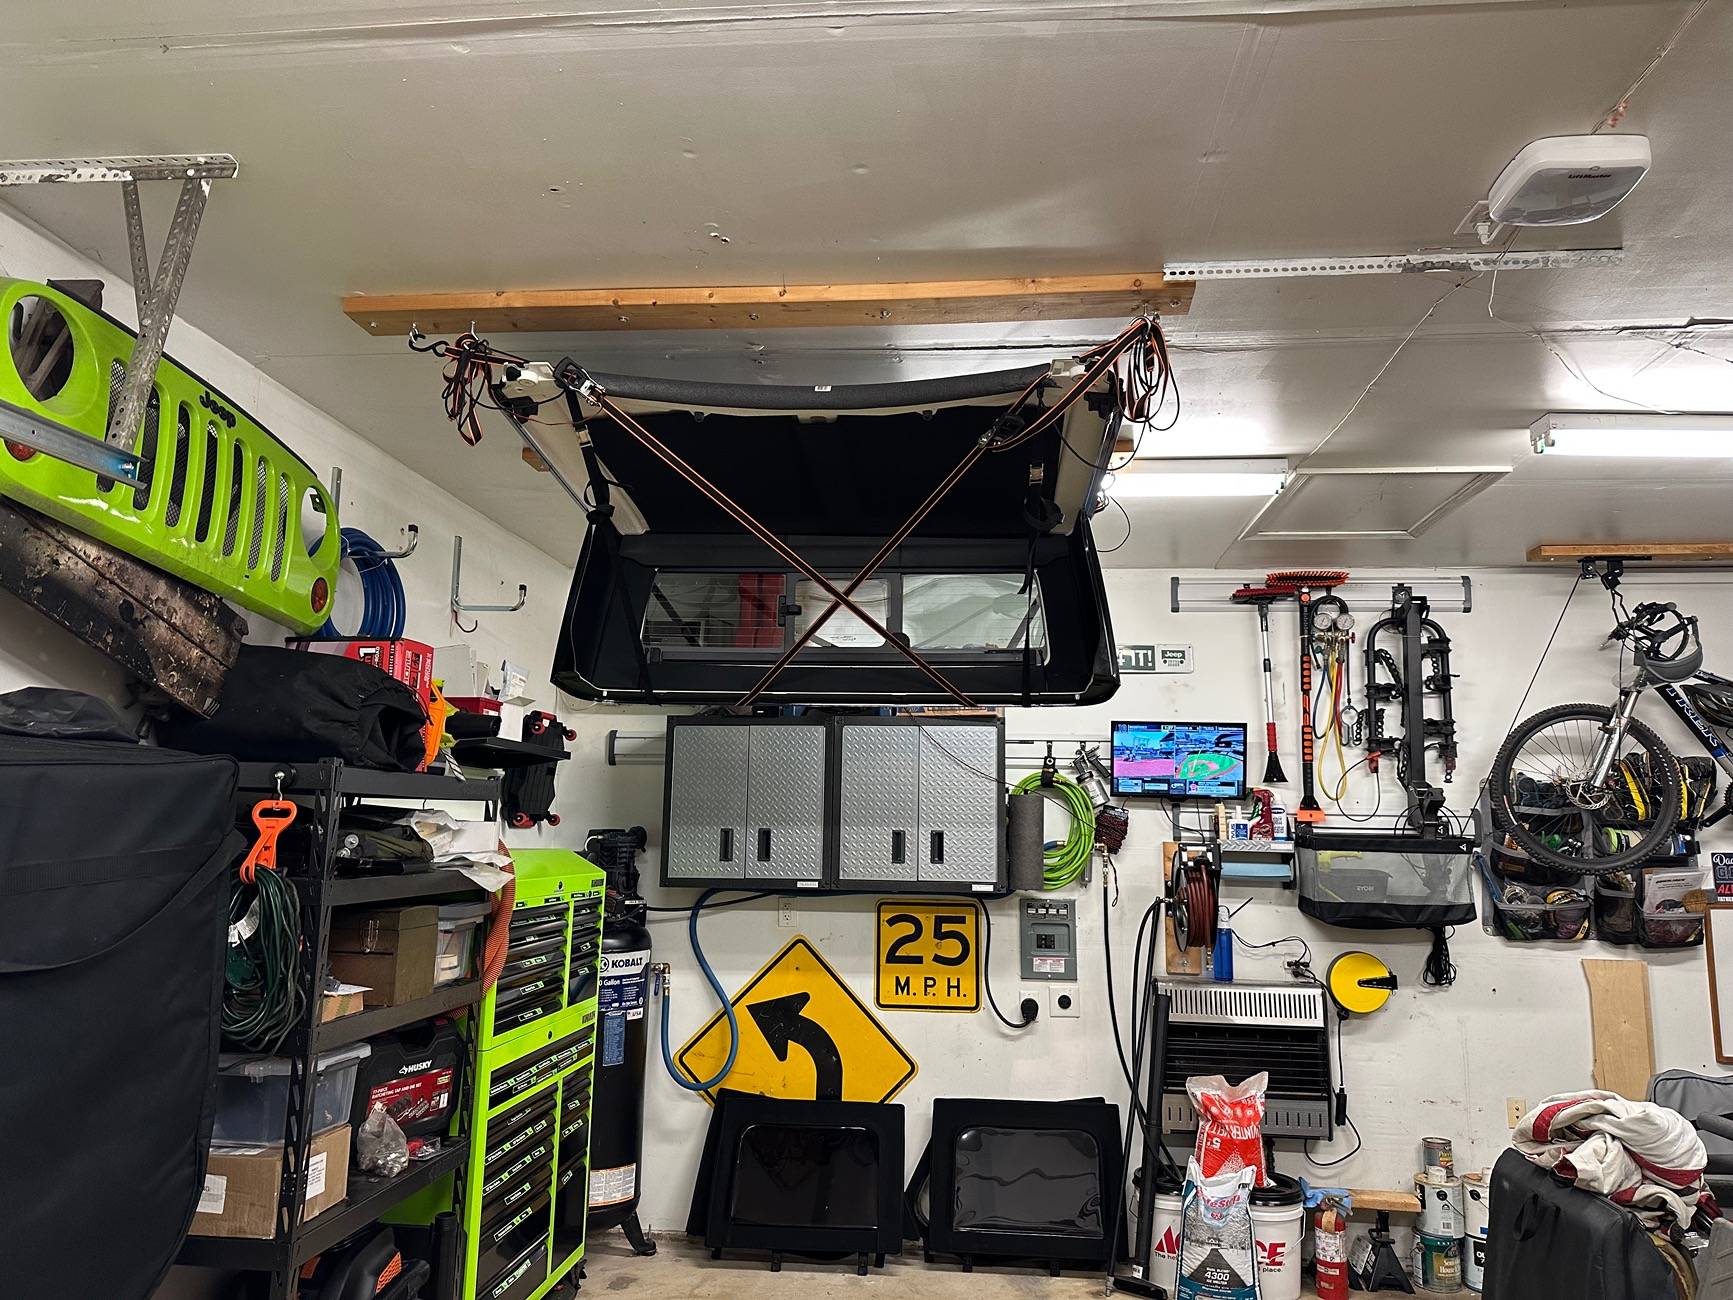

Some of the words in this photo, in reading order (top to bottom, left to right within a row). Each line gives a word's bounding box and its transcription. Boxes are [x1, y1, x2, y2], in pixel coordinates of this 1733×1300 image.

[199, 390, 236, 429] Jeep
[1164, 651, 1182, 659] Jeep
[1665, 686, 1719, 747] TREK
[1717, 884, 1733, 894] AL
[885, 913, 971, 967] 25
[611, 957, 643, 969] KOBALT
[408, 1060, 432, 1073] HUSKY
[1231, 1125, 1260, 1140] WINTER
[1204, 1271, 1230, 1281] 4300
